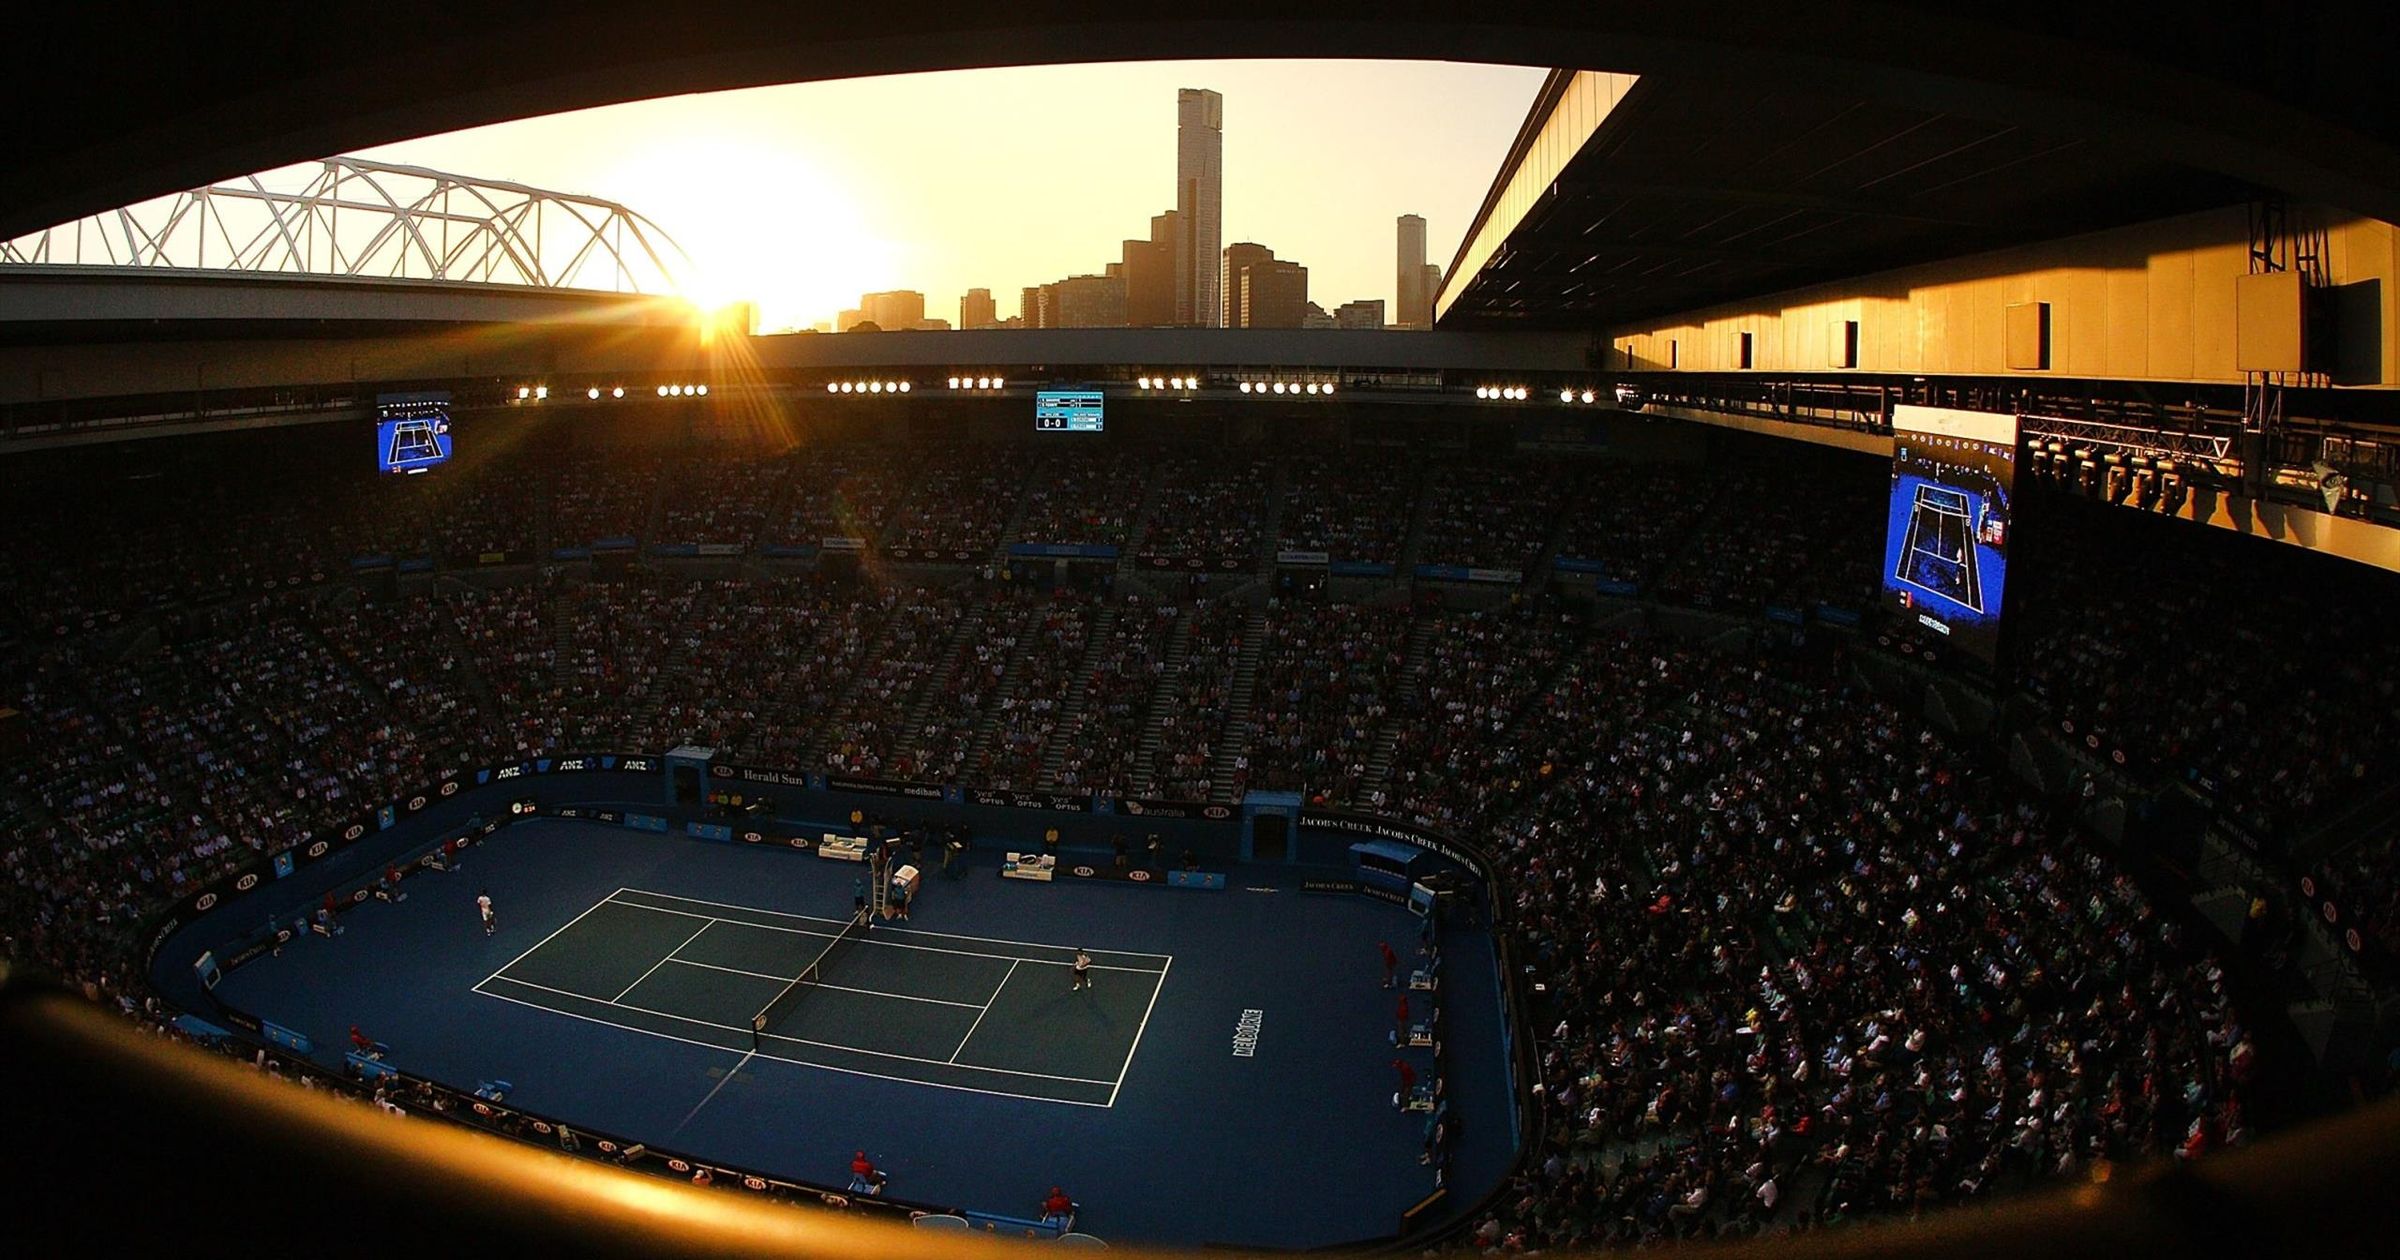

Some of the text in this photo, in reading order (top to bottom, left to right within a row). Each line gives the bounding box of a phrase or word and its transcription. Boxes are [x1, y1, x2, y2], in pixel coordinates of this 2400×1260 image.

[560, 760, 584, 771] ANZ
[624, 760, 647, 771] ANZ
[498, 766, 520, 779] ANZ
[744, 769, 803, 786] Herald Sun
[904, 787, 941, 798] medibank
[410, 797, 425, 809] KIA
[980, 798, 1004, 806] OPTUS
[1016, 800, 1042, 808] OPTUS
[1055, 803, 1081, 812] OPTUS
[1205, 807, 1229, 818] KIA
[1300, 816, 1373, 834] JACOB'S CREEK
[347, 826, 363, 839] KIA
[1375, 825, 1438, 851] JACOB'S CREEK
[310, 842, 327, 856] KIA
[1075, 867, 1093, 876] KIA
[1130, 870, 1149, 881] KIA
[238, 874, 257, 889] KIA
[197, 894, 216, 910] KIA
[1232, 1009, 1263, 1057] MELBOURNE
[534, 1122, 550, 1133] KIA
[599, 1141, 616, 1151] KIA
[669, 1160, 688, 1171] KIA
[746, 1178, 765, 1189] KIA
